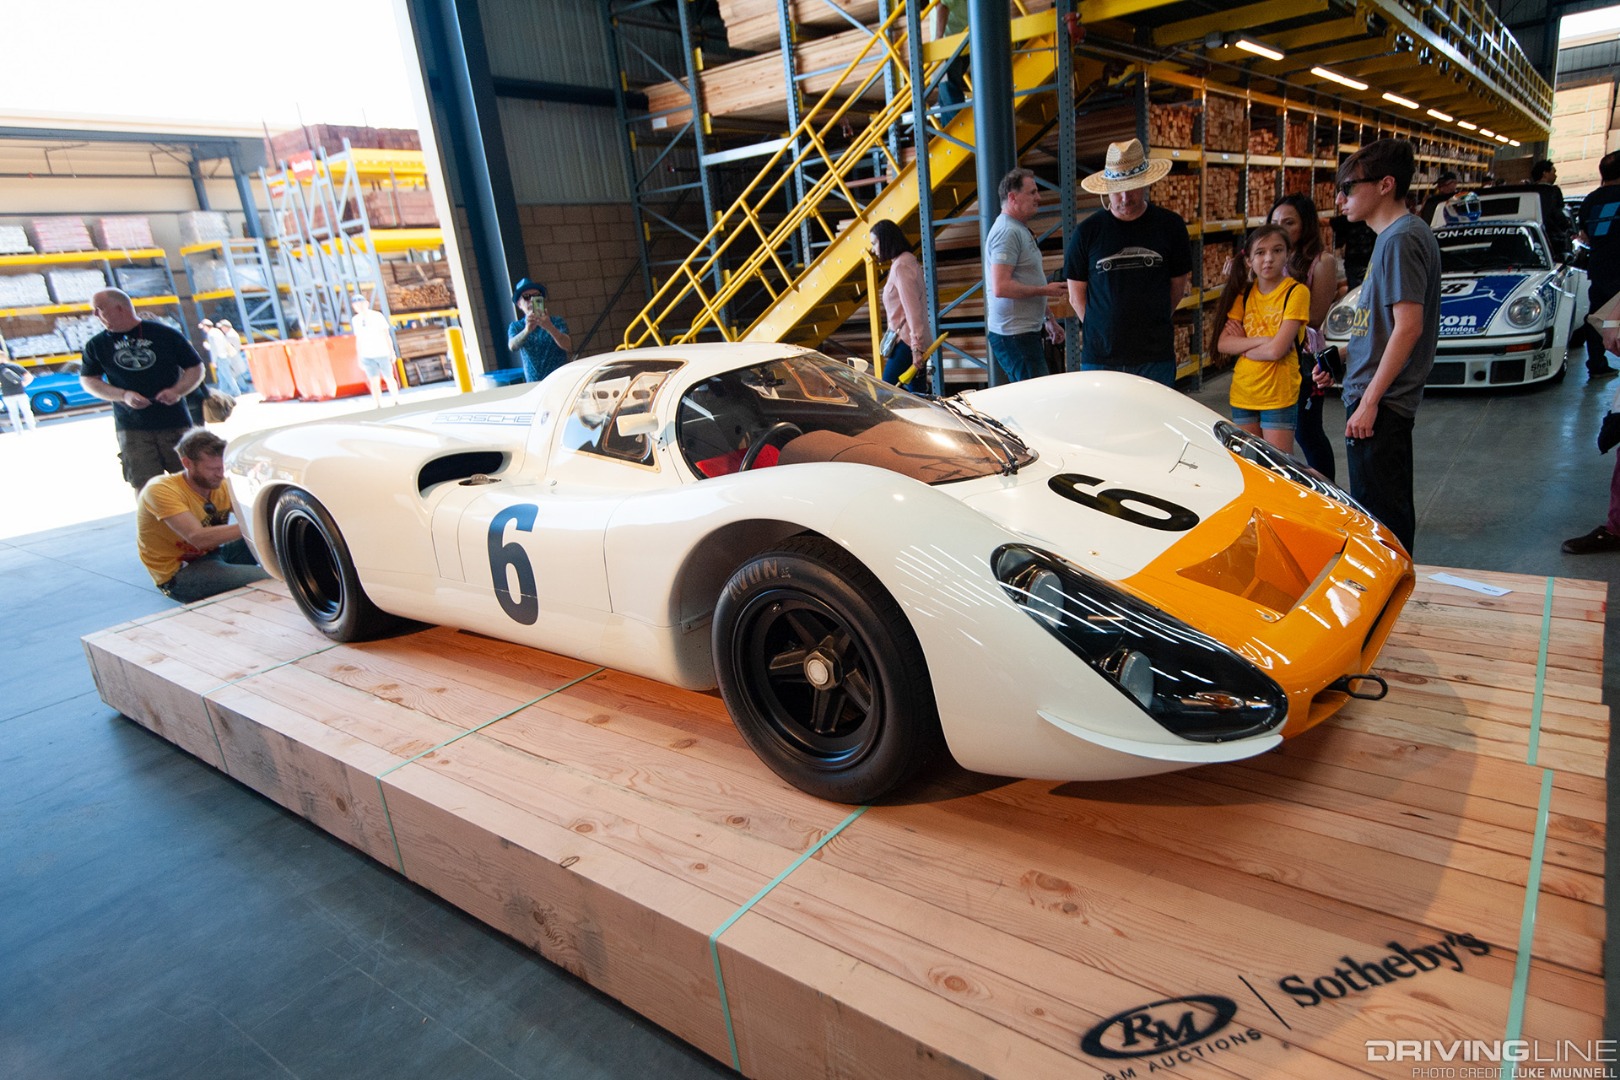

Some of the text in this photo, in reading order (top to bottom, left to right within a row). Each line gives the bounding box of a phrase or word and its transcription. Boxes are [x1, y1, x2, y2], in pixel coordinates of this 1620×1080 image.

[1531, 359, 1551, 371] Shell
[435, 415, 532, 423] PORSCHE
[1047, 473, 1200, 532] 6
[487, 503, 539, 626] 6
[1278, 933, 1491, 1008] Sotheby's
[1116, 1011, 1200, 1048] RM
[1149, 1028, 1262, 1073] AUCTIONS
